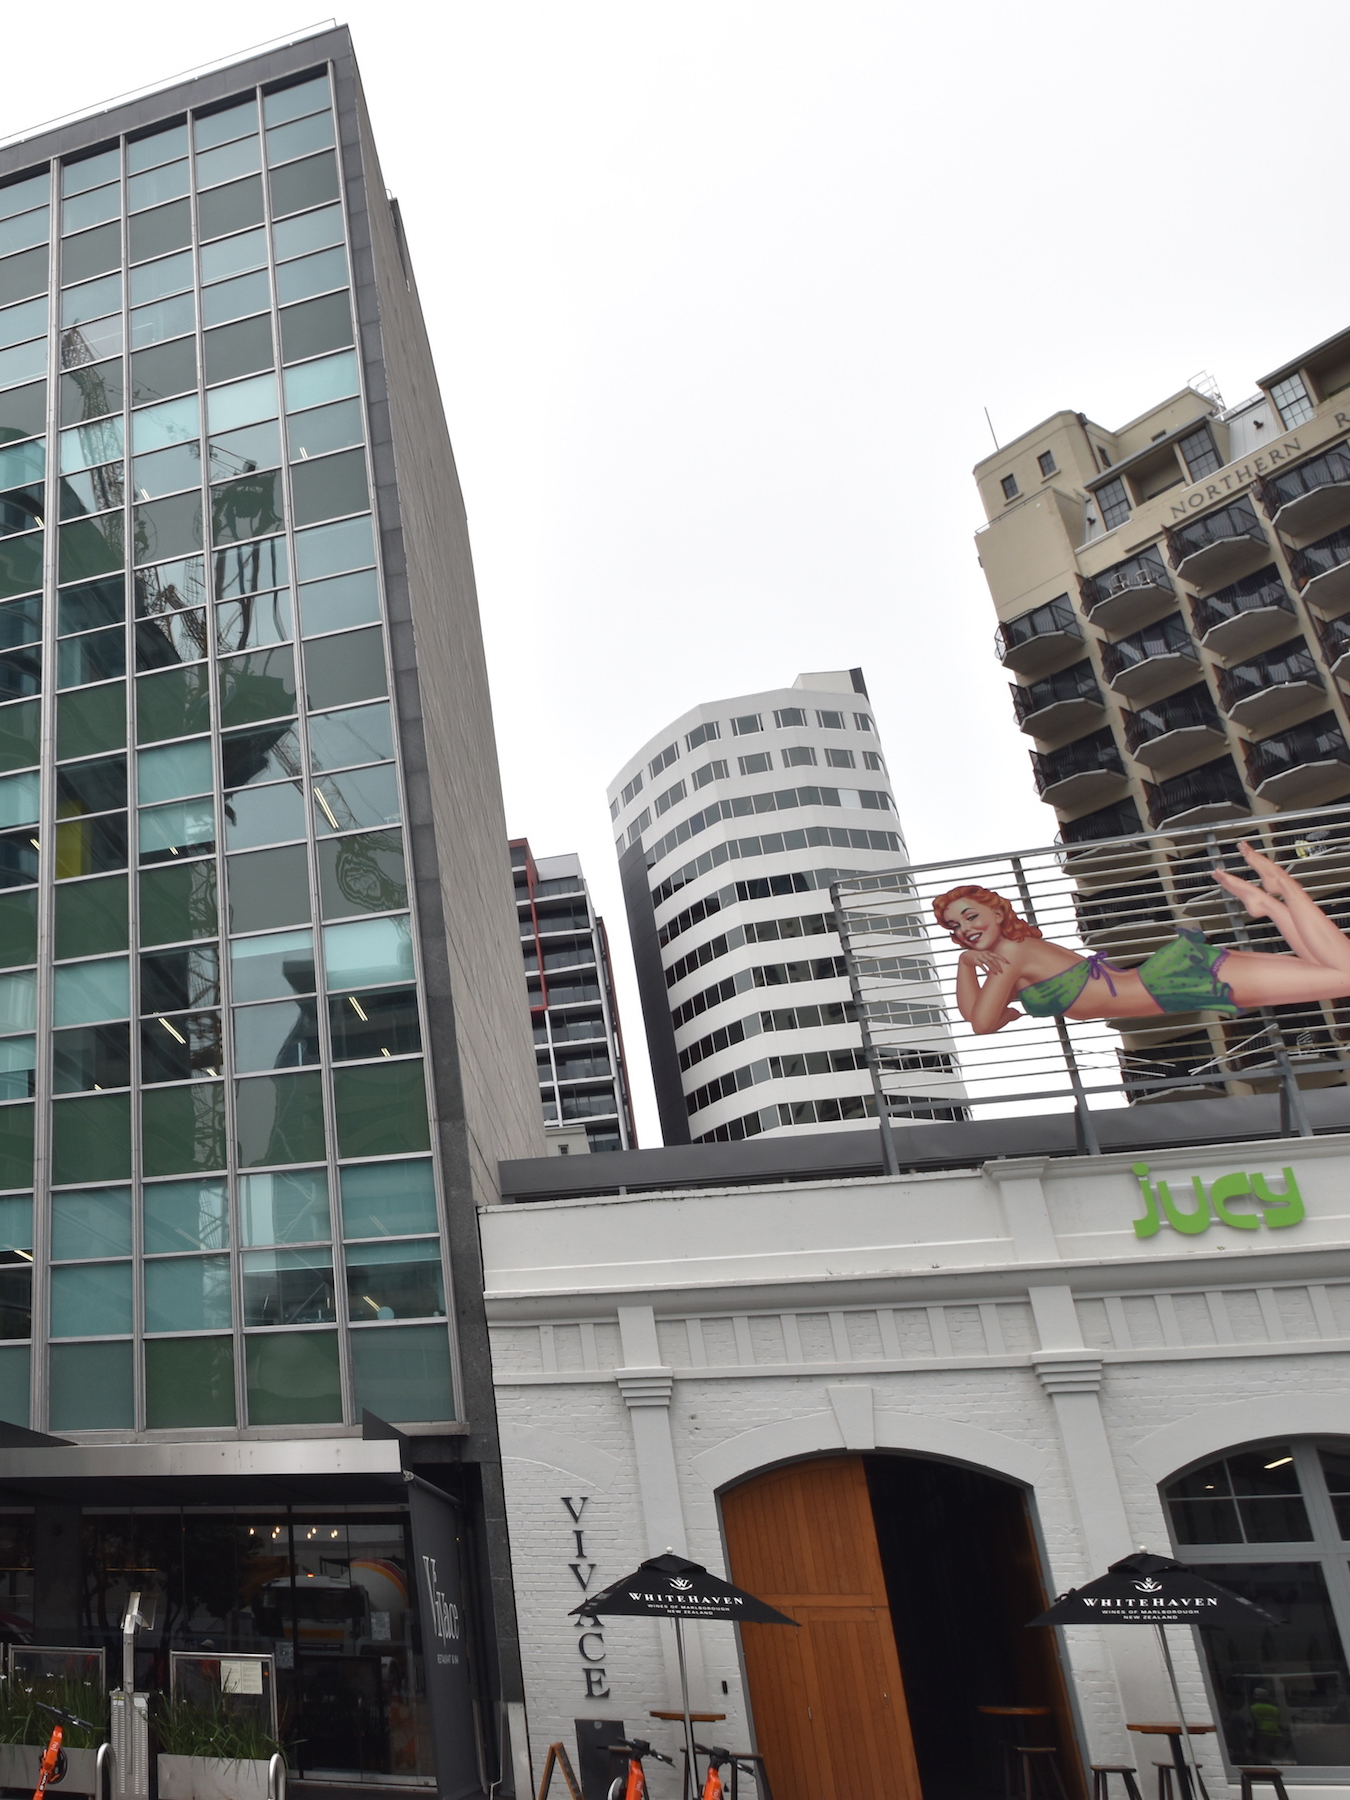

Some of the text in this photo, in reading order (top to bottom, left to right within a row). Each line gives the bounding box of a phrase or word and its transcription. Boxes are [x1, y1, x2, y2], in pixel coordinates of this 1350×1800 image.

[1170, 437, 1302, 519] NORTHERN
[1133, 1162, 1305, 1239] jucy
[629, 1592, 744, 1605] WHITEHAVEN
